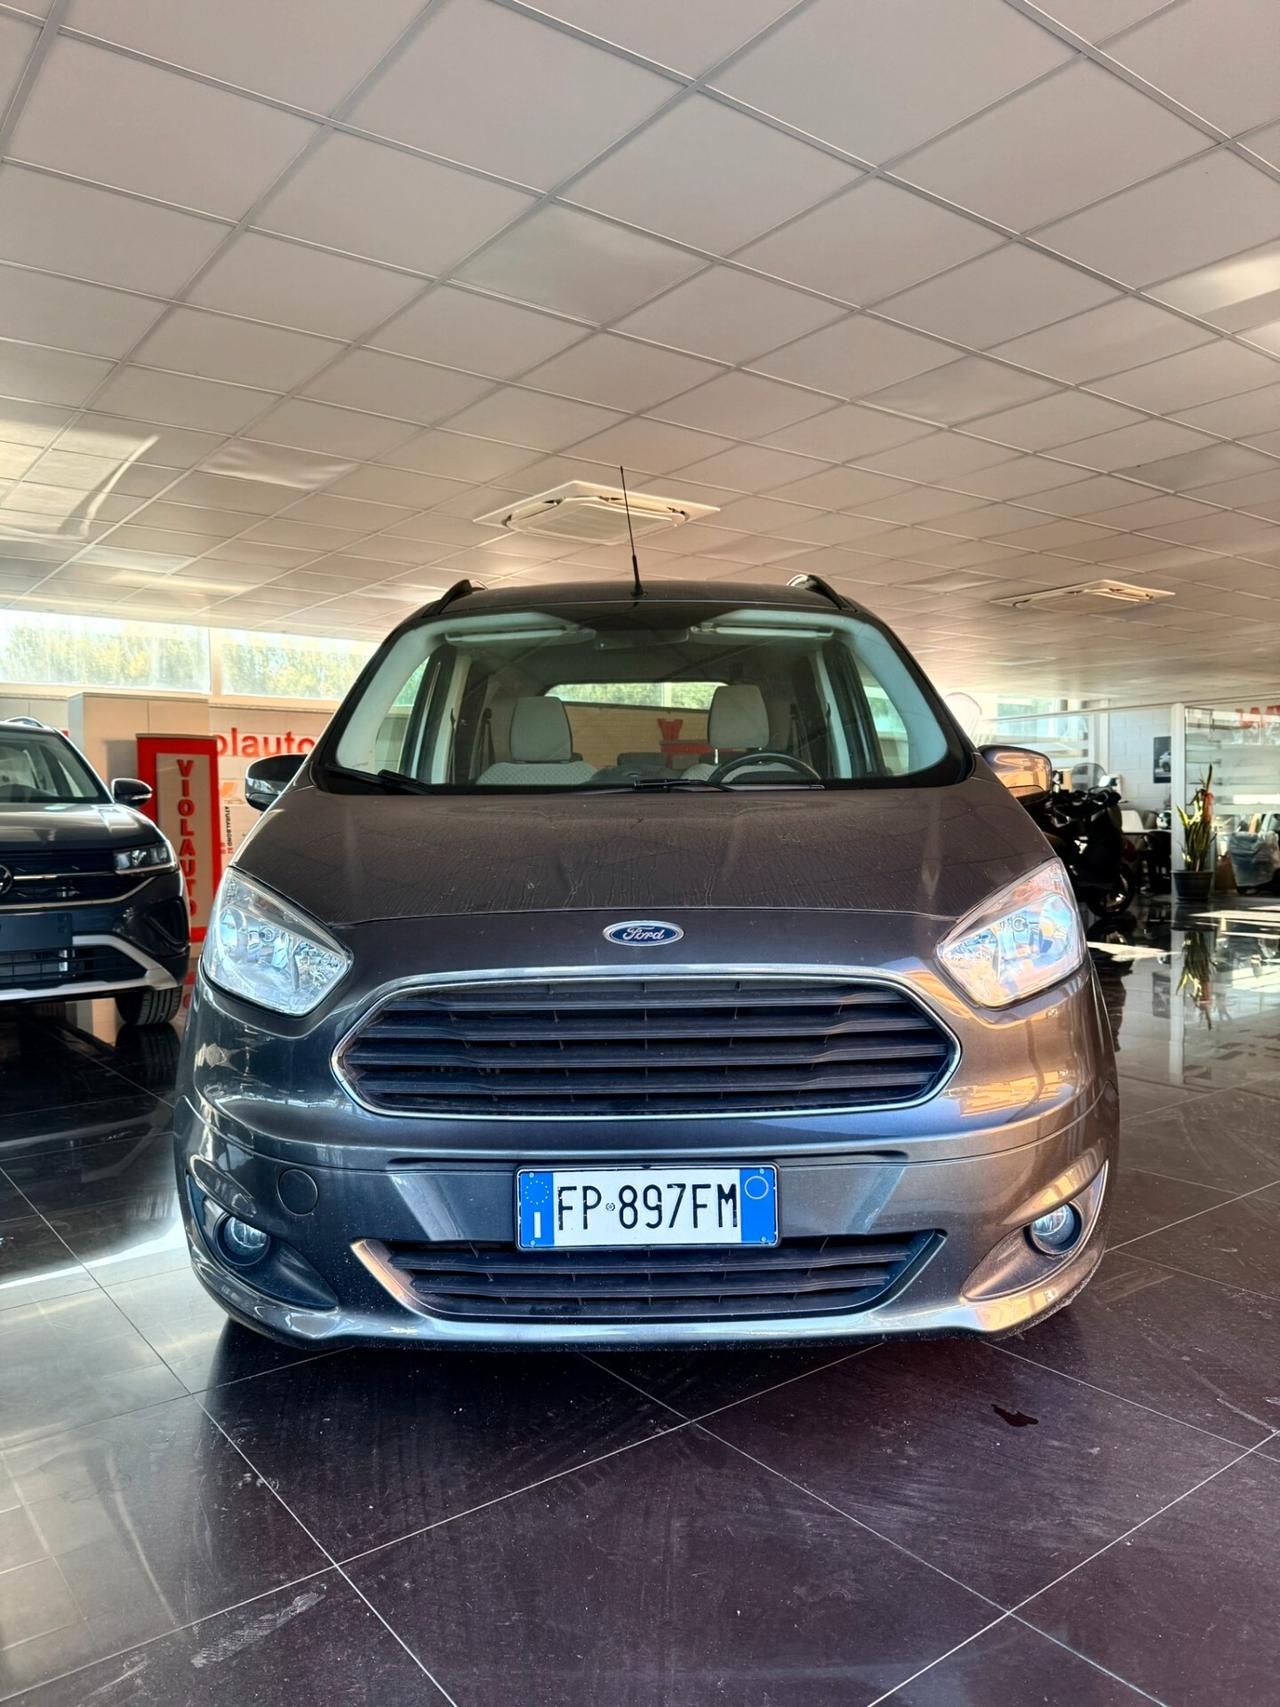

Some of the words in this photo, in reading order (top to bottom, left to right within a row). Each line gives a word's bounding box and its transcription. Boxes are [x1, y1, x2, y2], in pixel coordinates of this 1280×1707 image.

[622, 926, 665, 940] Ford
[557, 1185, 602, 1231] FP
[618, 1183, 738, 1230] 897FM
